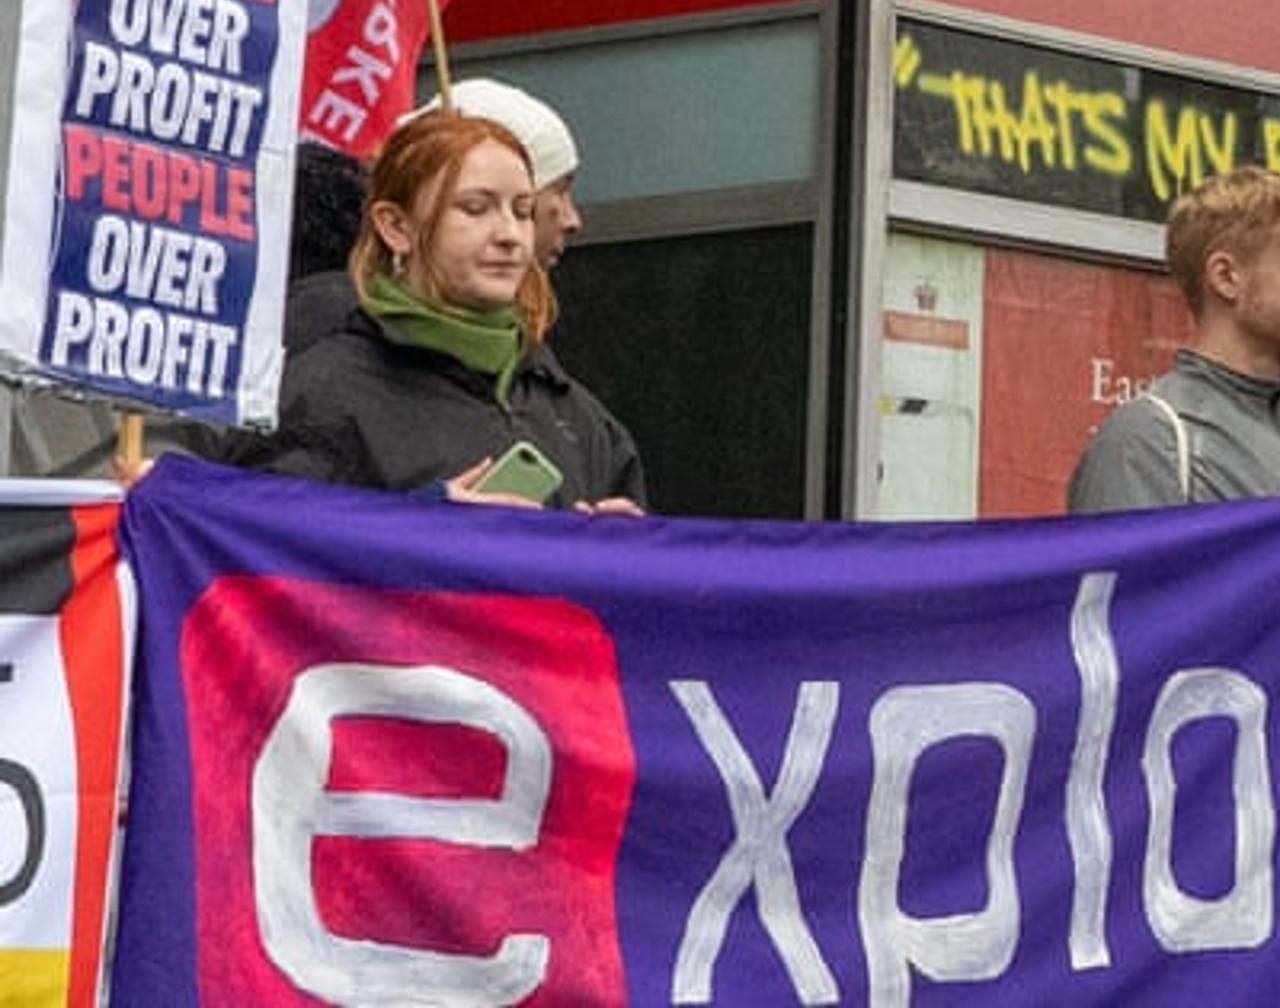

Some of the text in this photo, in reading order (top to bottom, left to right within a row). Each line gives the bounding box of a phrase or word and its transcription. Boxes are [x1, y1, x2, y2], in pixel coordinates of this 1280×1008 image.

[75, 41, 261, 159] PROFIT
[63, 123, 257, 240] PEOPLE
[87, 216, 226, 314] OVER
[49, 292, 239, 400] PROFIT
[1091, 358, 1156, 404] Eas
